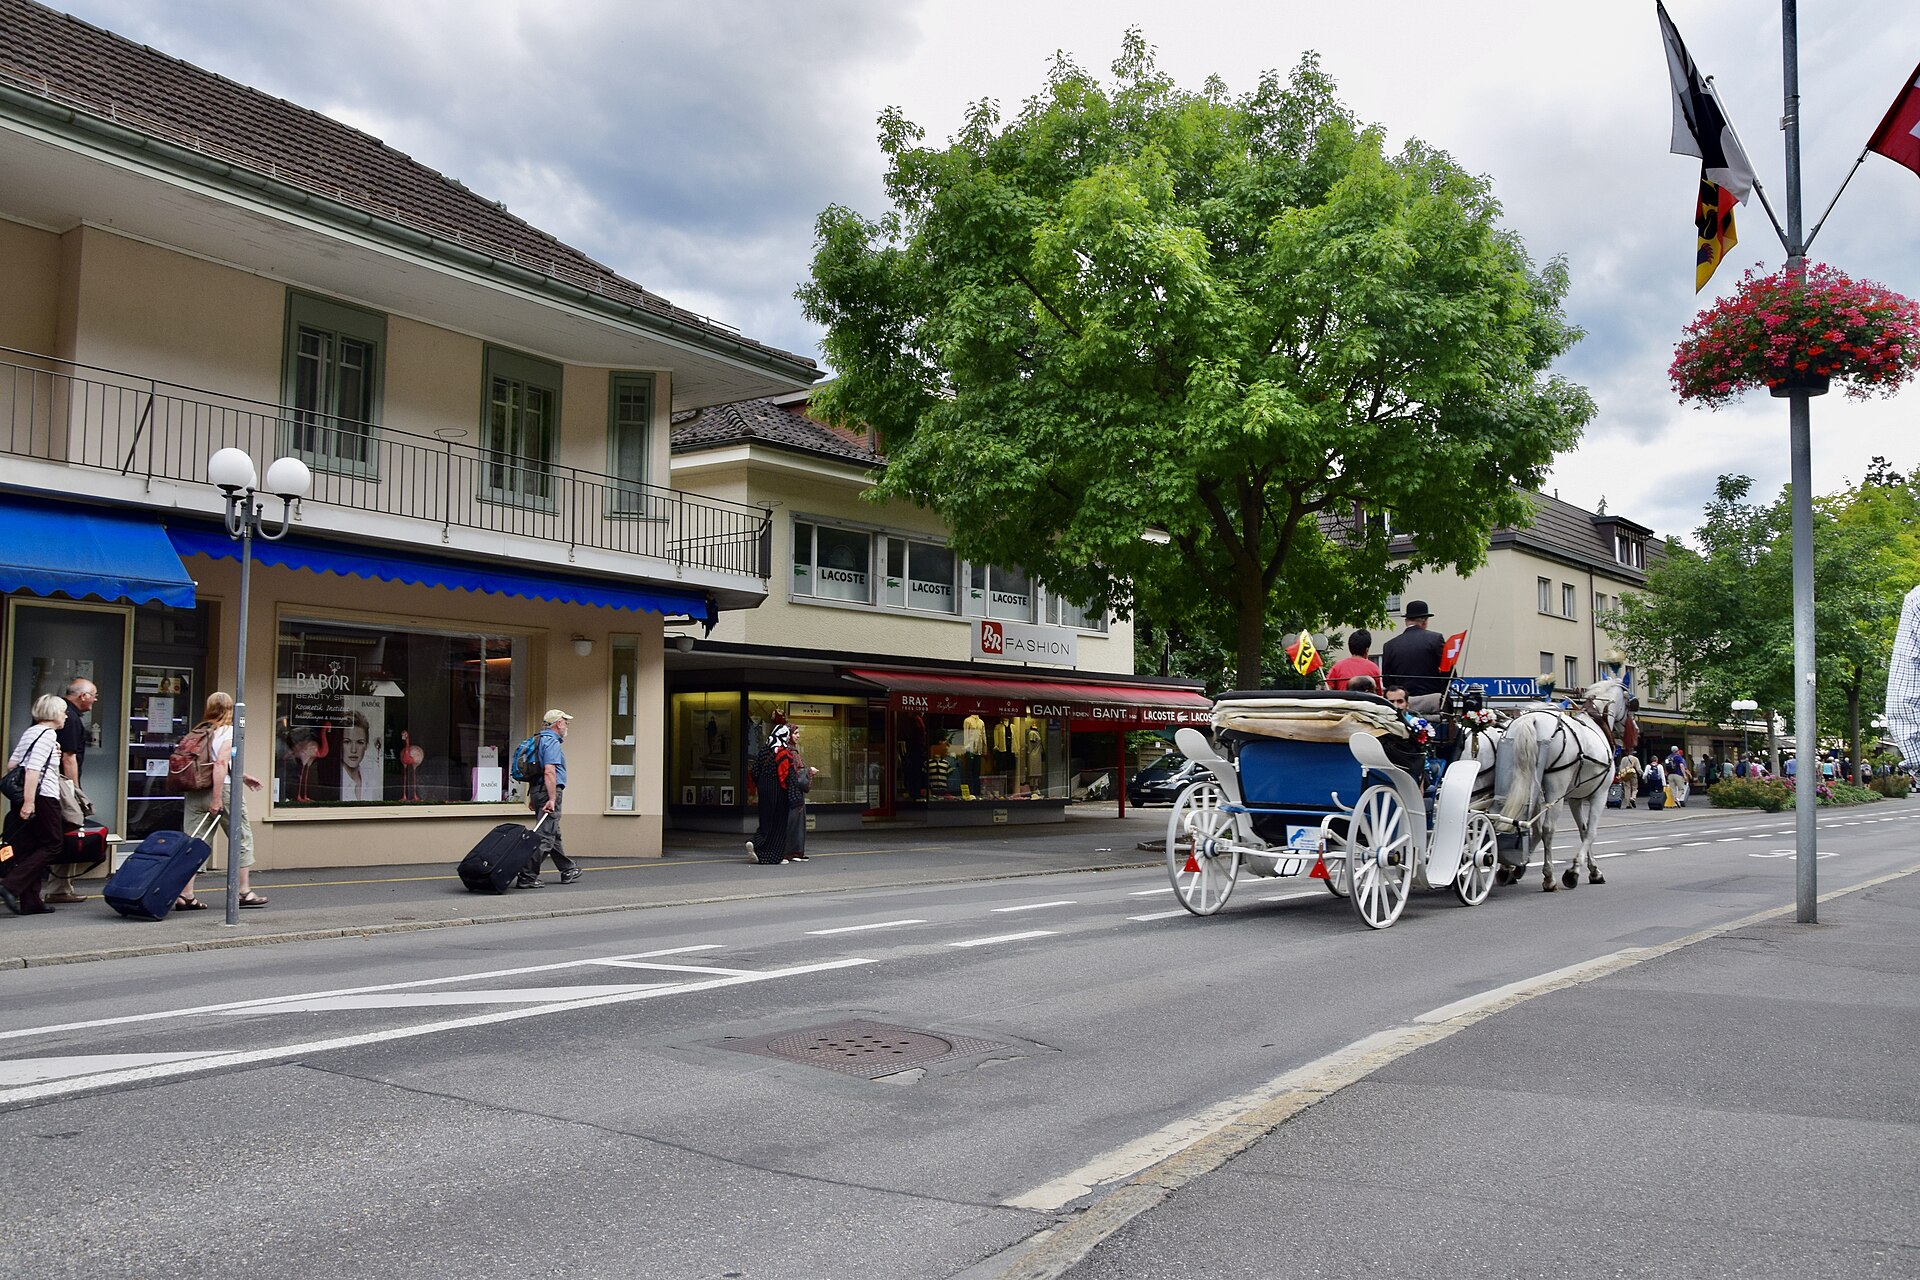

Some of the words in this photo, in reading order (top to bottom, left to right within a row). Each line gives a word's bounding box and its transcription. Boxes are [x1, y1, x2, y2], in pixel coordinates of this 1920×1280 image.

[821, 569, 865, 585] LACOSTE
[912, 581, 951, 596] LACOSTE
[992, 592, 1027, 606] LACOSTE
[1005, 637, 1070, 656] FASHION
[296, 672, 350, 692] BABOR
[295, 703, 323, 711] Kosmetik
[902, 695, 928, 706] BRAX
[1033, 704, 1070, 716] GANT
[1092, 707, 1127, 719] GANT
[1144, 711, 1175, 721] LACOSTE
[1191, 712, 1213, 722] LACOS
